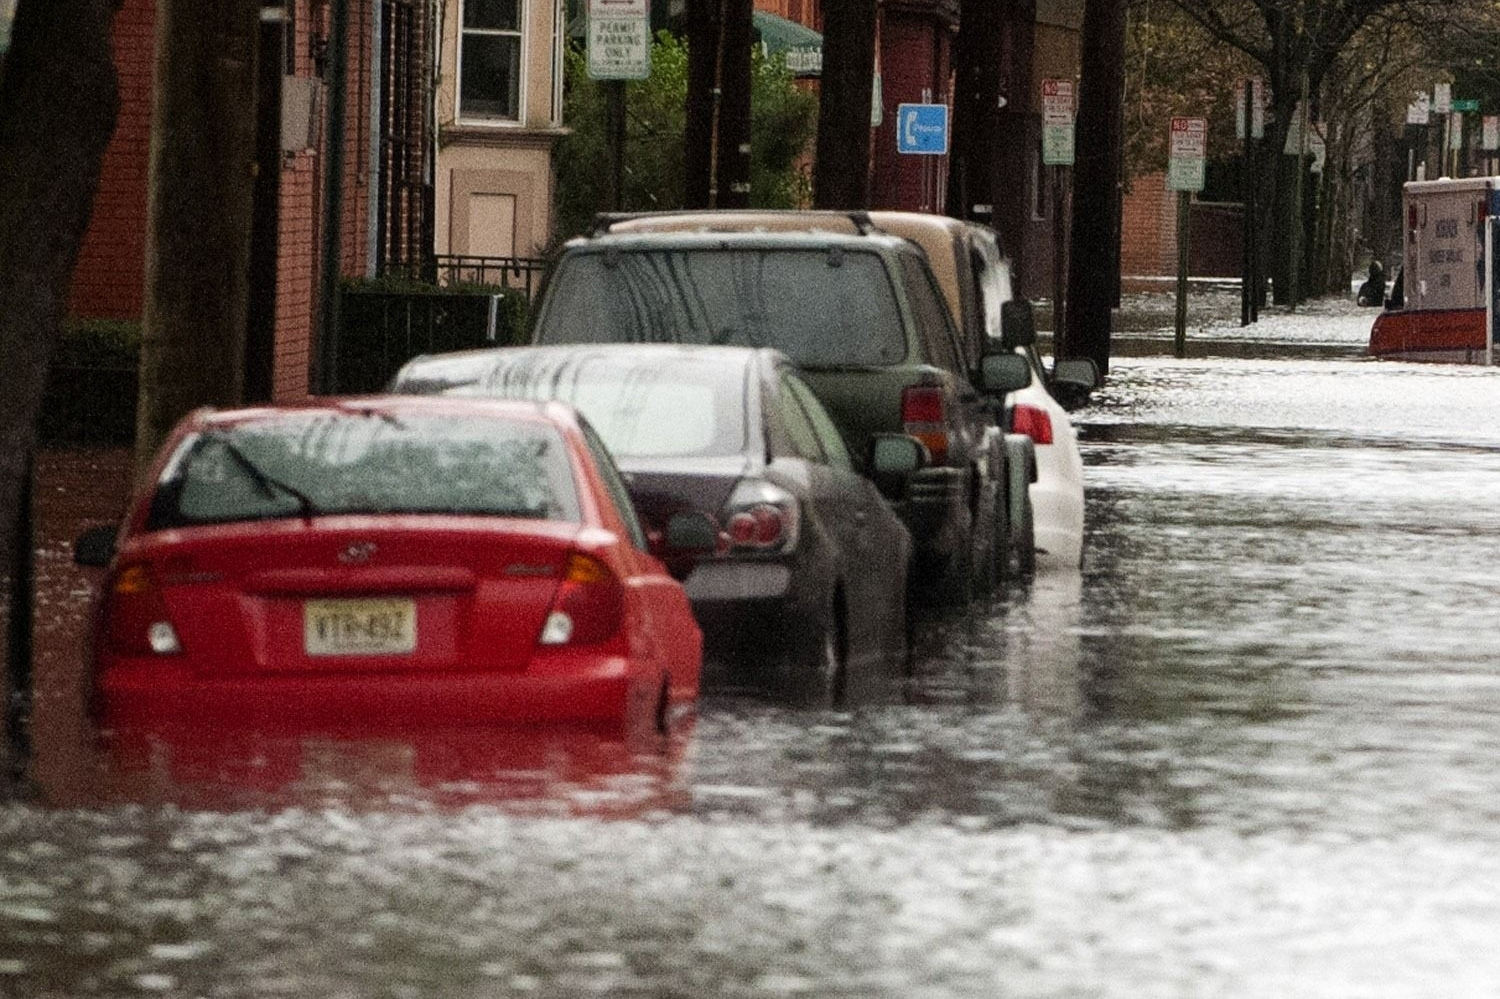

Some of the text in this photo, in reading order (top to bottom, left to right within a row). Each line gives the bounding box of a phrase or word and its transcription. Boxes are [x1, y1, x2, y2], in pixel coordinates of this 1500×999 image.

[600, 22, 636, 33] PERMIT
[597, 35, 641, 45] PARKING
[605, 48, 631, 59] ONLY
